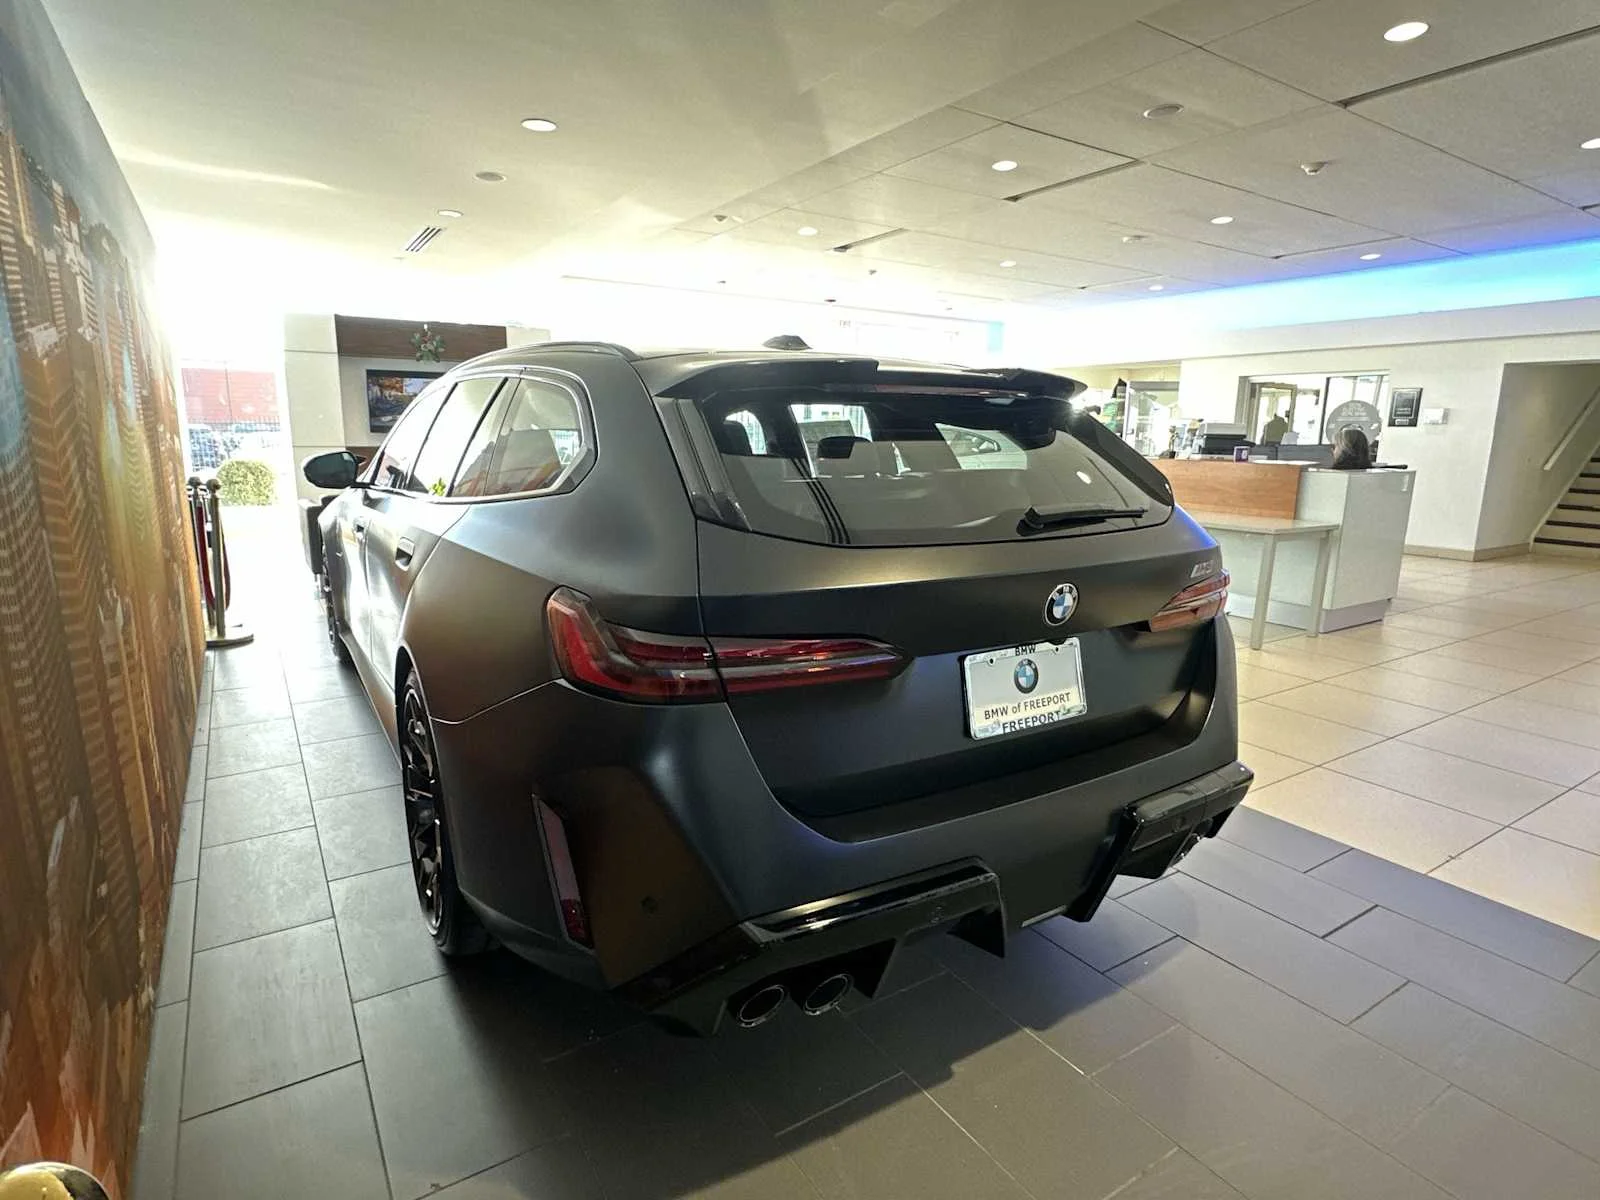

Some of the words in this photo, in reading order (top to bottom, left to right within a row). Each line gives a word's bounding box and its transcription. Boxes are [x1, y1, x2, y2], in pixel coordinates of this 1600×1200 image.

[1015, 645, 1036, 656] BMW
[984, 705, 1009, 720] BMW
[1012, 702, 1022, 714] of
[1024, 692, 1071, 711] FREEPORT
[1002, 710, 1060, 734] FREEPORT
